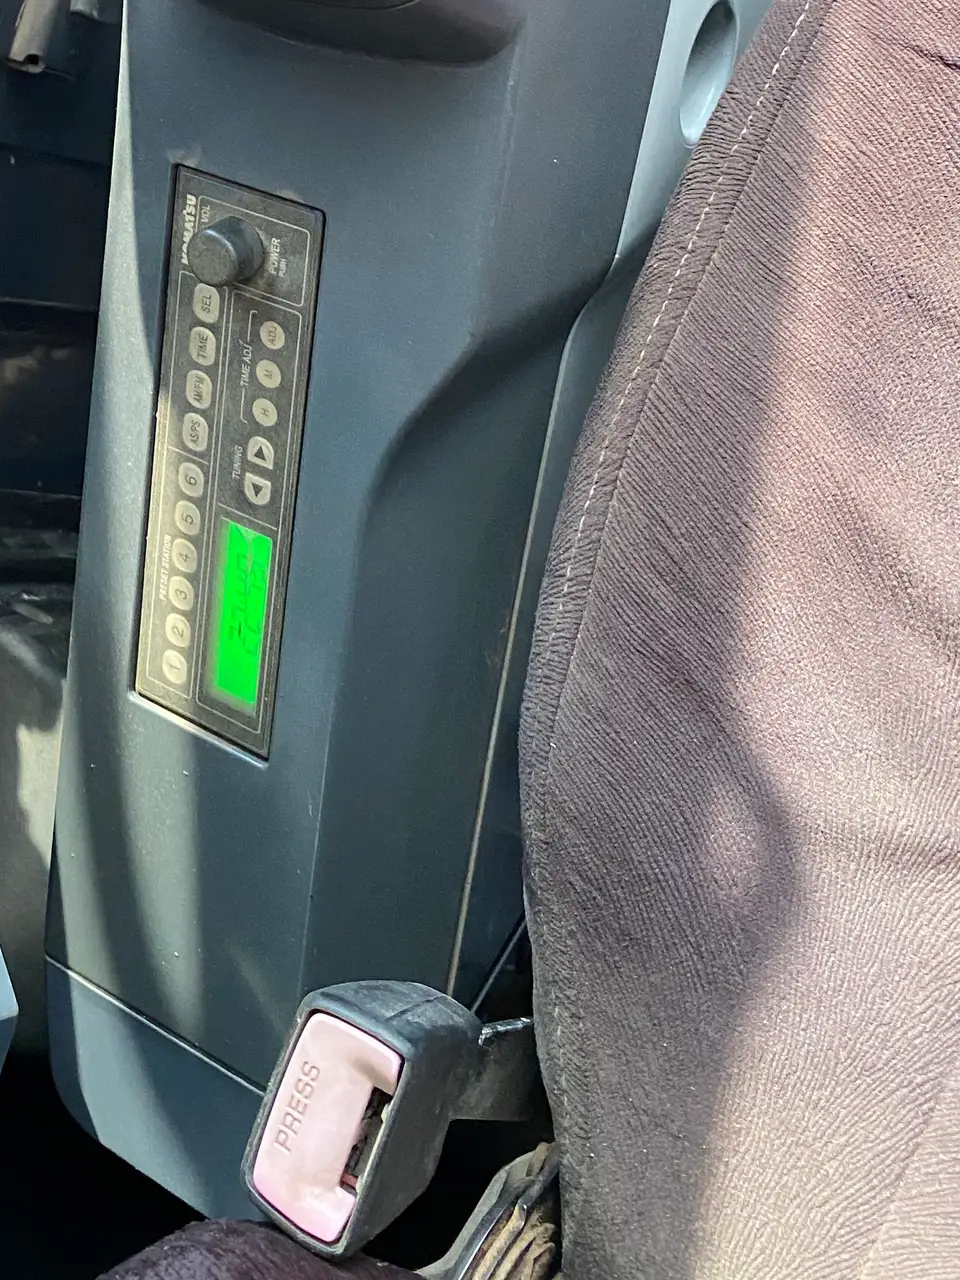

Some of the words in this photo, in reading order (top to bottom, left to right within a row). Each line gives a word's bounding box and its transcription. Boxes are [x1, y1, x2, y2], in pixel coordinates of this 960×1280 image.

[200, 204, 211, 223] VOL
[268, 237, 281, 275] POWER
[278, 258, 288, 278] PUSH
[201, 293, 212, 314] SEL
[197, 332, 208, 360] TIME
[267, 325, 278, 346] ADJ
[240, 363, 251, 387] TIME
[263, 368, 273, 380] M
[192, 376, 206, 403] AM/FM
[260, 407, 270, 418] H
[189, 419, 201, 445] AS/PS
[231, 445, 243, 480] TUNING
[184, 474, 197, 486] 6
[182, 513, 194, 525] 5
[163, 533, 172, 570] STATION
[178, 552, 190, 563] 4
[159, 570, 169, 602] PRESET
[174, 588, 187, 600] 3
[172, 627, 184, 639] 2
[273, 1060, 321, 1155] PRESS
